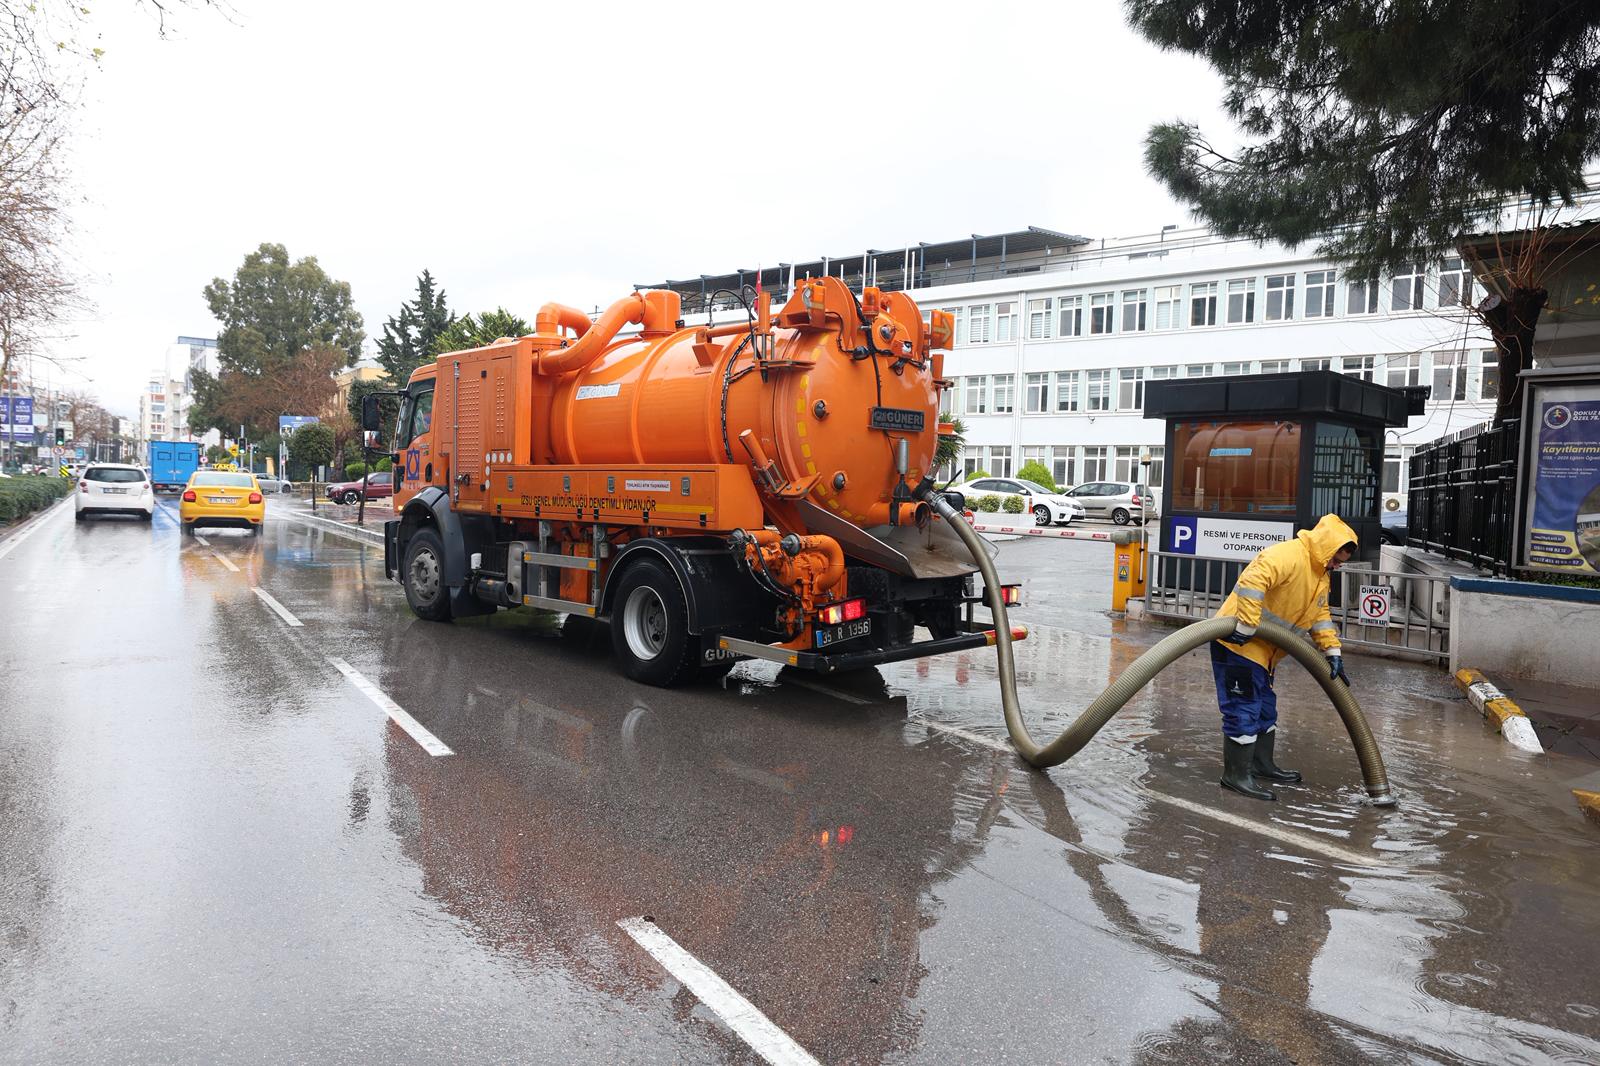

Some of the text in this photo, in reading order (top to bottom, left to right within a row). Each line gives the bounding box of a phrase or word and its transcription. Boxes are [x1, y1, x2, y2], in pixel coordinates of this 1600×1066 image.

[887, 411, 923, 424] GÜNERİ
[534, 495, 551, 506] GENEL
[1203, 530, 1229, 539] RESMİ
[823, 621, 869, 644] 35 R 1356
